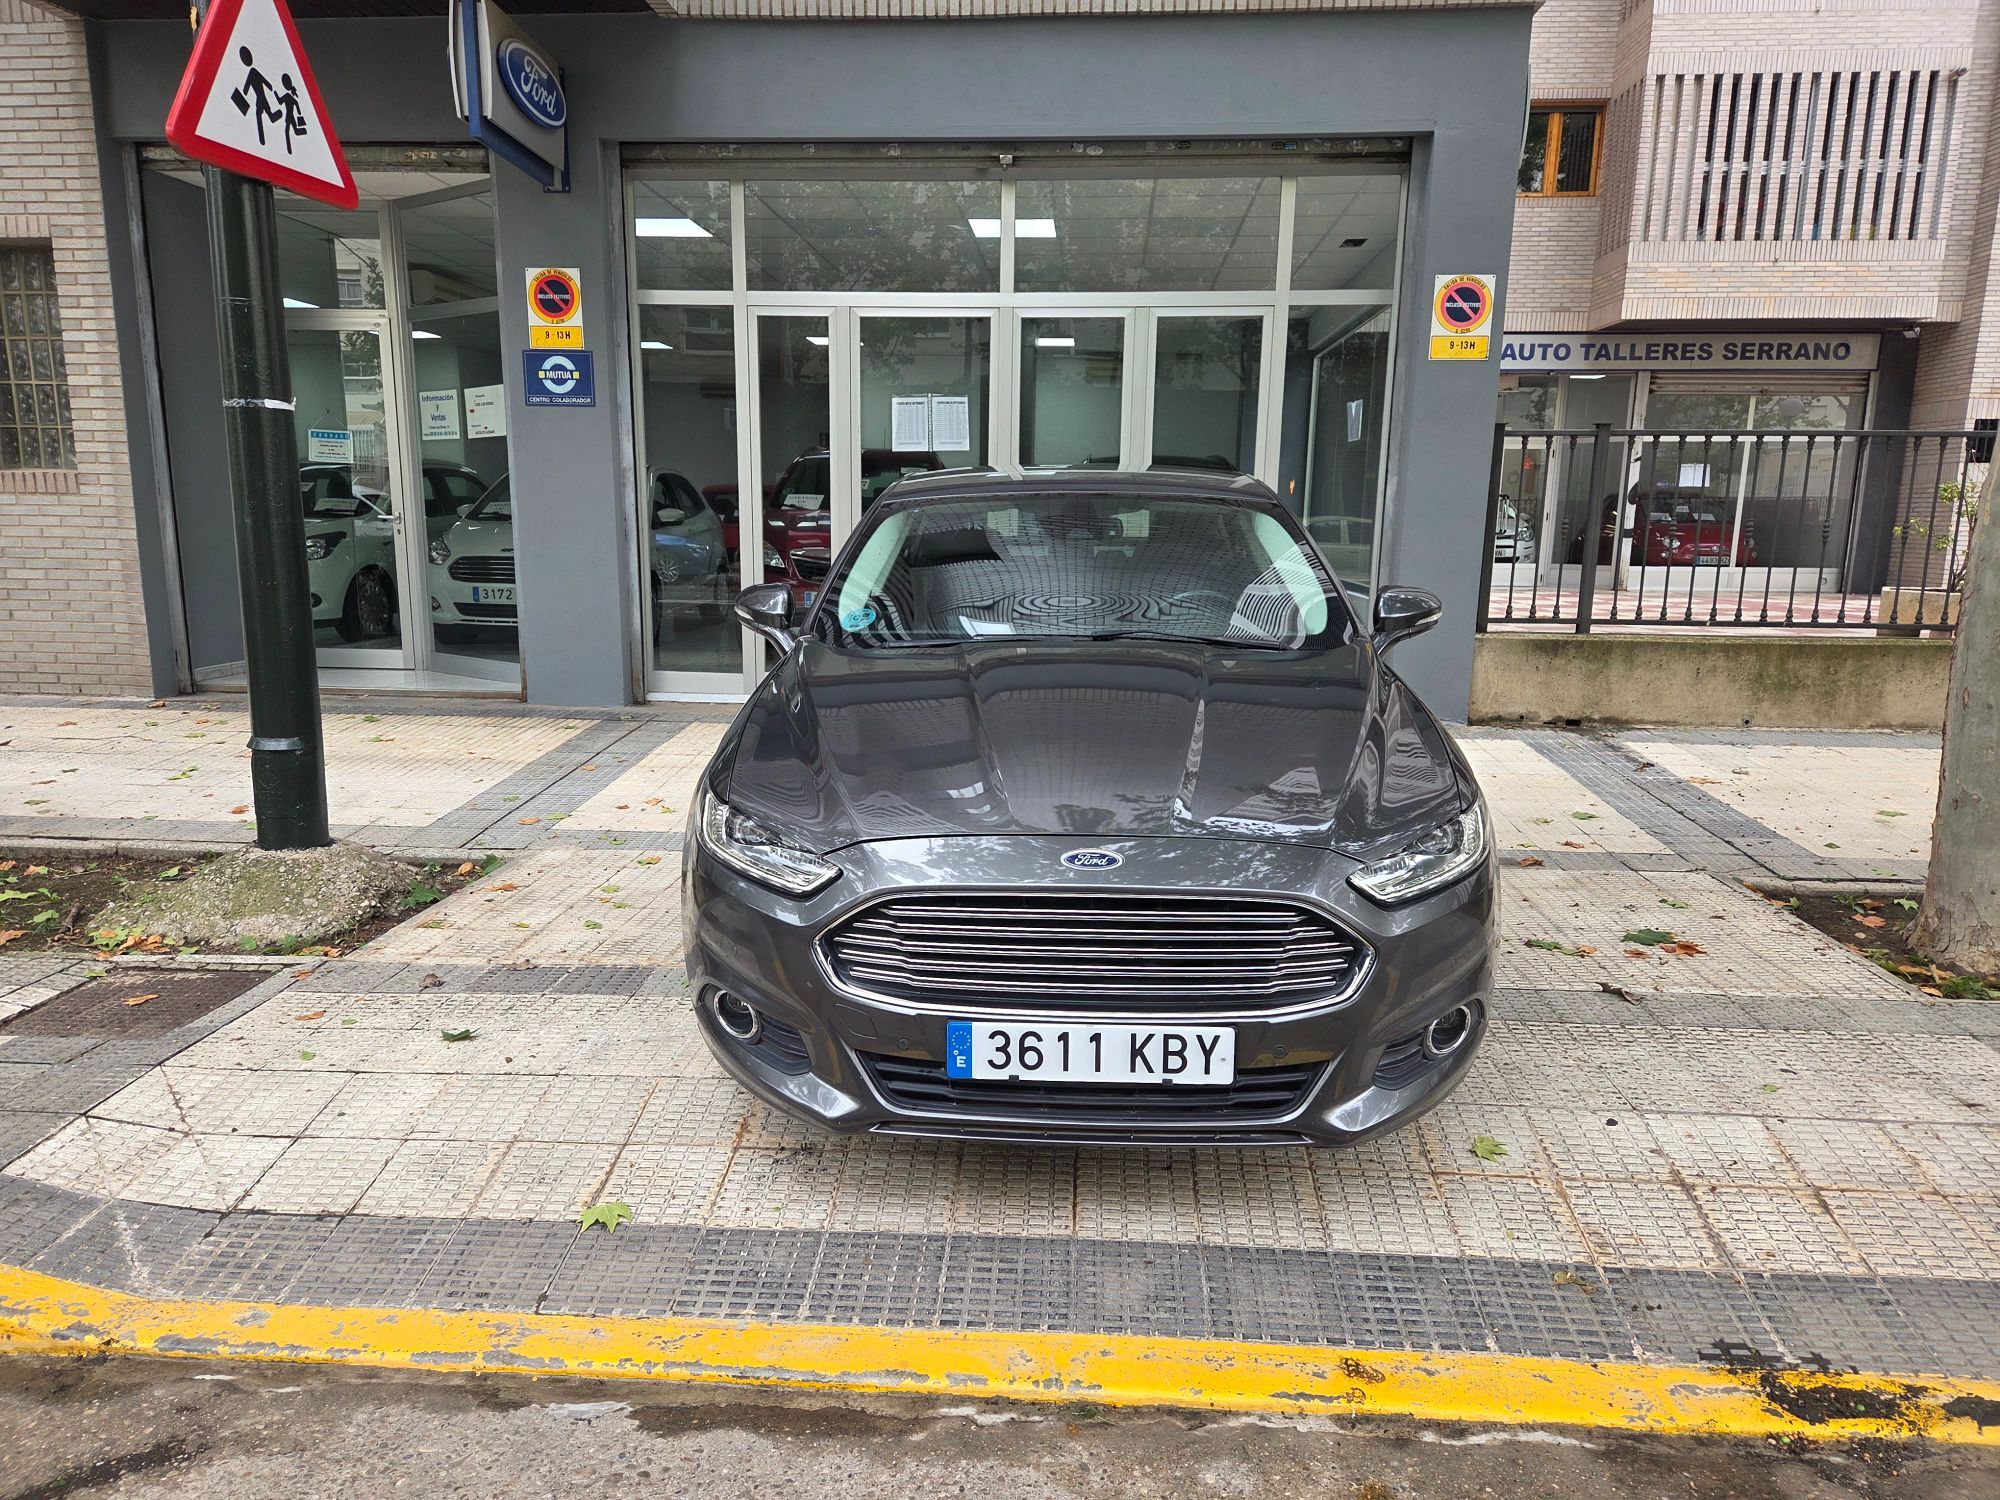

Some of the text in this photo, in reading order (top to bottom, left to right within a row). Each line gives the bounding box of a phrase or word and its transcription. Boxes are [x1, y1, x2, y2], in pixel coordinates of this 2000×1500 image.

[521, 56, 556, 115] Ford
[534, 271, 546, 282] SALIDA
[1444, 278, 1458, 290] SALIDA
[1501, 342, 1852, 361] AUTO TALLERES SERRANO
[546, 371, 571, 379] MUTUA
[421, 394, 454, 402] Información
[482, 589, 513, 600] 3172
[1074, 852, 1109, 866] Ford
[956, 1030, 1221, 1076] E 3611 KBY
